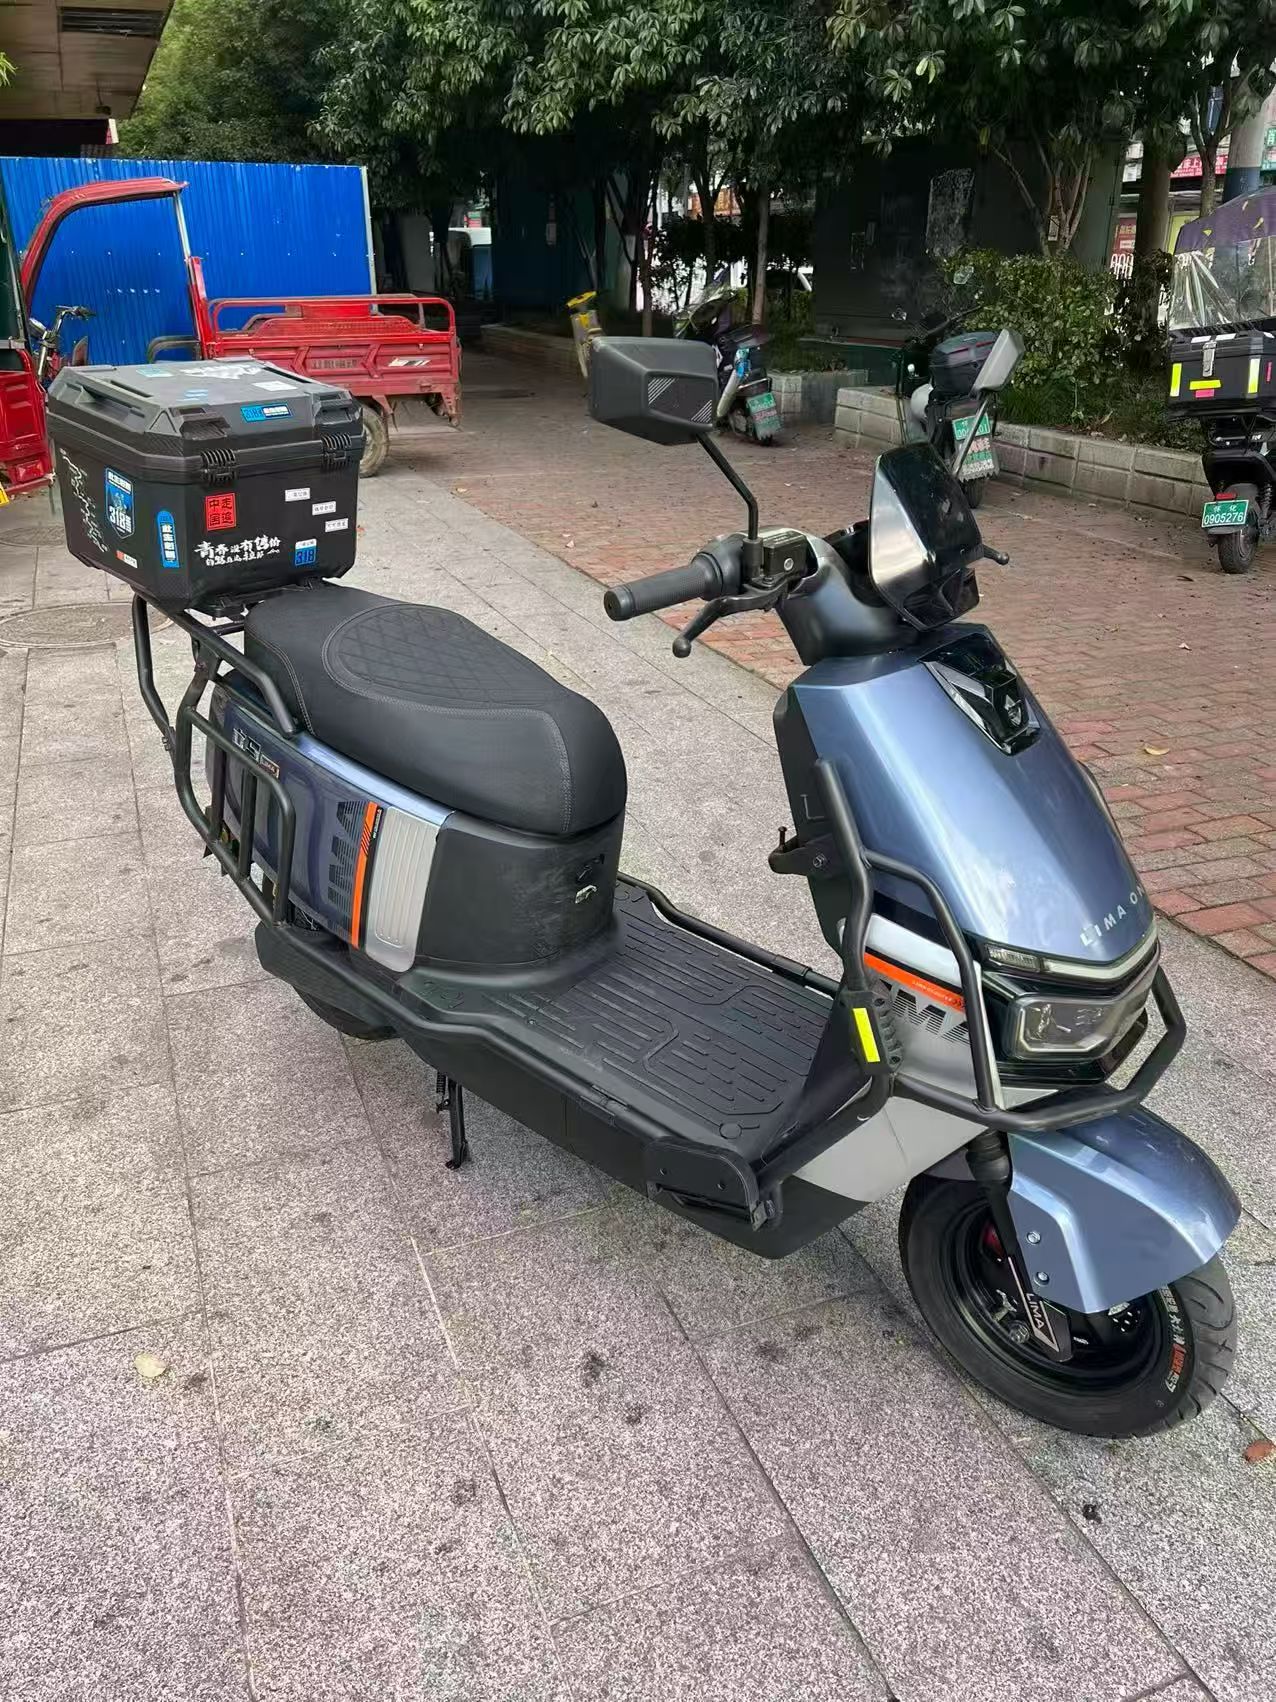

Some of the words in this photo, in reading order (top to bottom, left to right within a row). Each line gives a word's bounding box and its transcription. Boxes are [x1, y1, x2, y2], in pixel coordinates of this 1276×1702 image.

[1204, 512, 1244, 525] 0905276
[295, 549, 316, 565] 318
[1080, 904, 1127, 947] LIMA
[1026, 1293, 1045, 1329] LIMA
